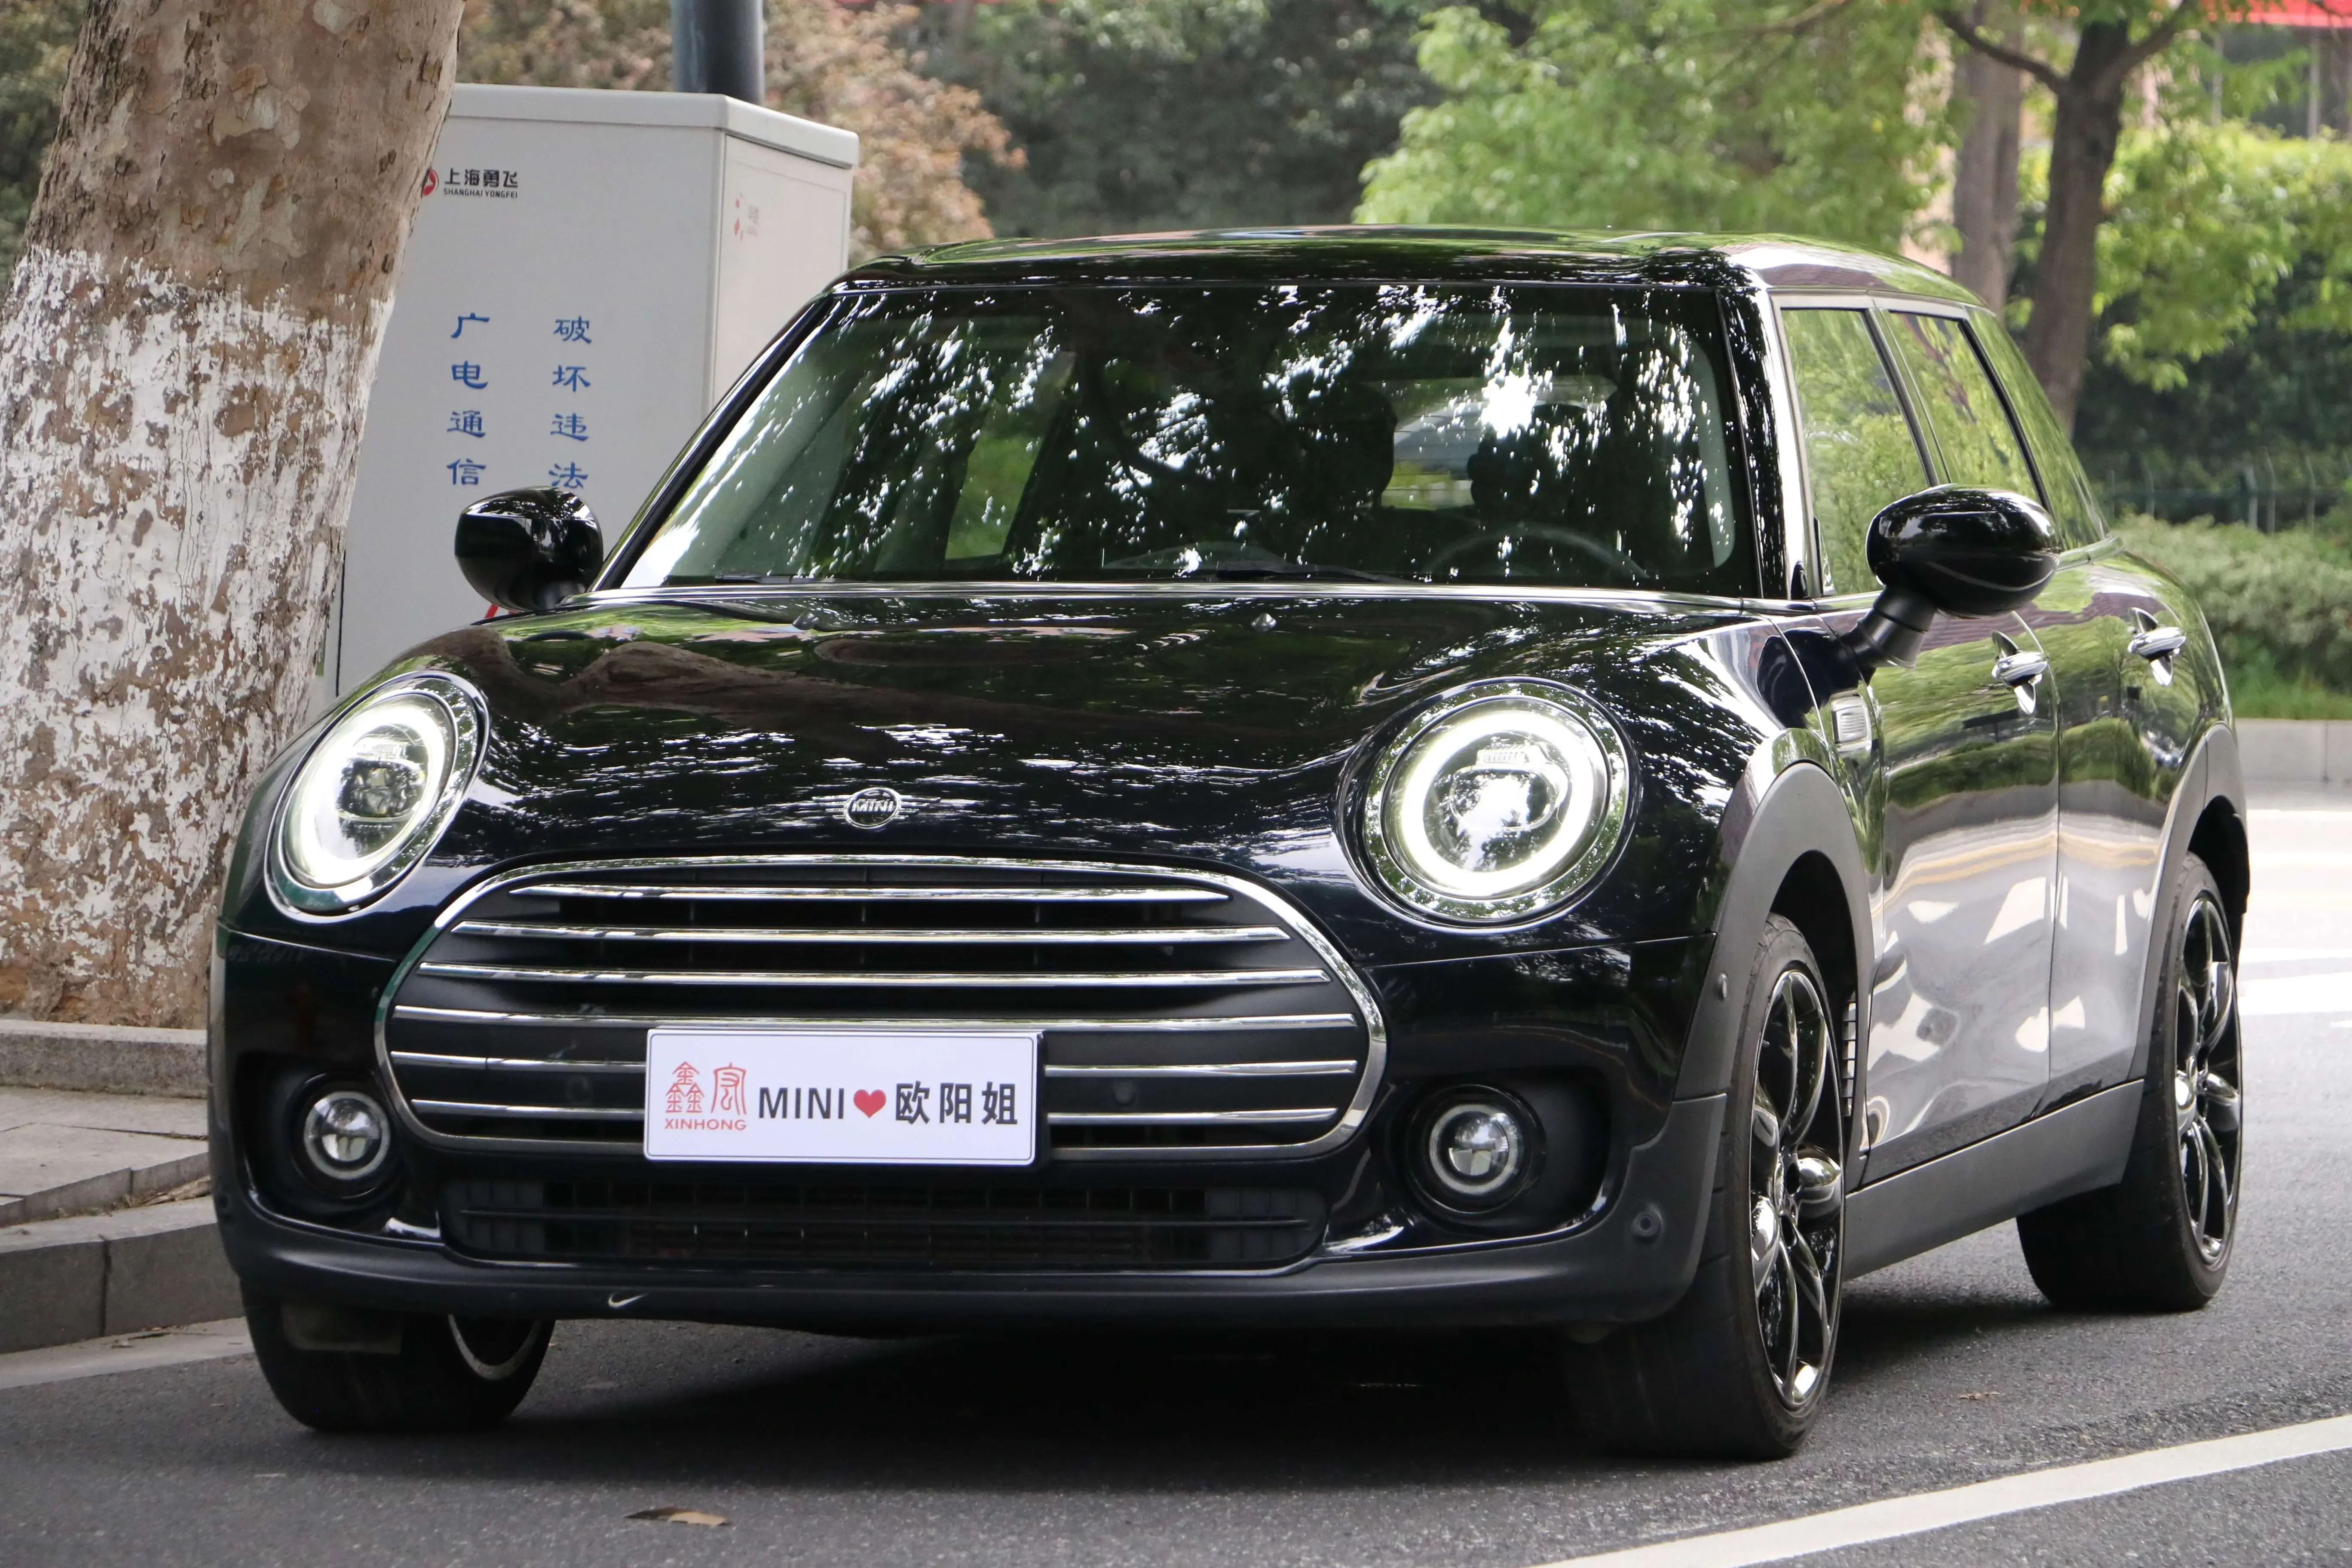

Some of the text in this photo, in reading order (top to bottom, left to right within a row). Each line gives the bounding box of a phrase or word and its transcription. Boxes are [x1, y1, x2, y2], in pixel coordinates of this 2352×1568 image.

[444, 167, 518, 188] 上海勇飞
[444, 188, 518, 199] SHANGHAI YONGFEI
[446, 312, 490, 485] 广电通信
[548, 316, 592, 489] 破坏违法
[851, 800, 894, 812] MINI
[759, 1080, 1018, 1125] MINI 欧阳姐
[665, 1118, 747, 1131] XINHONG
